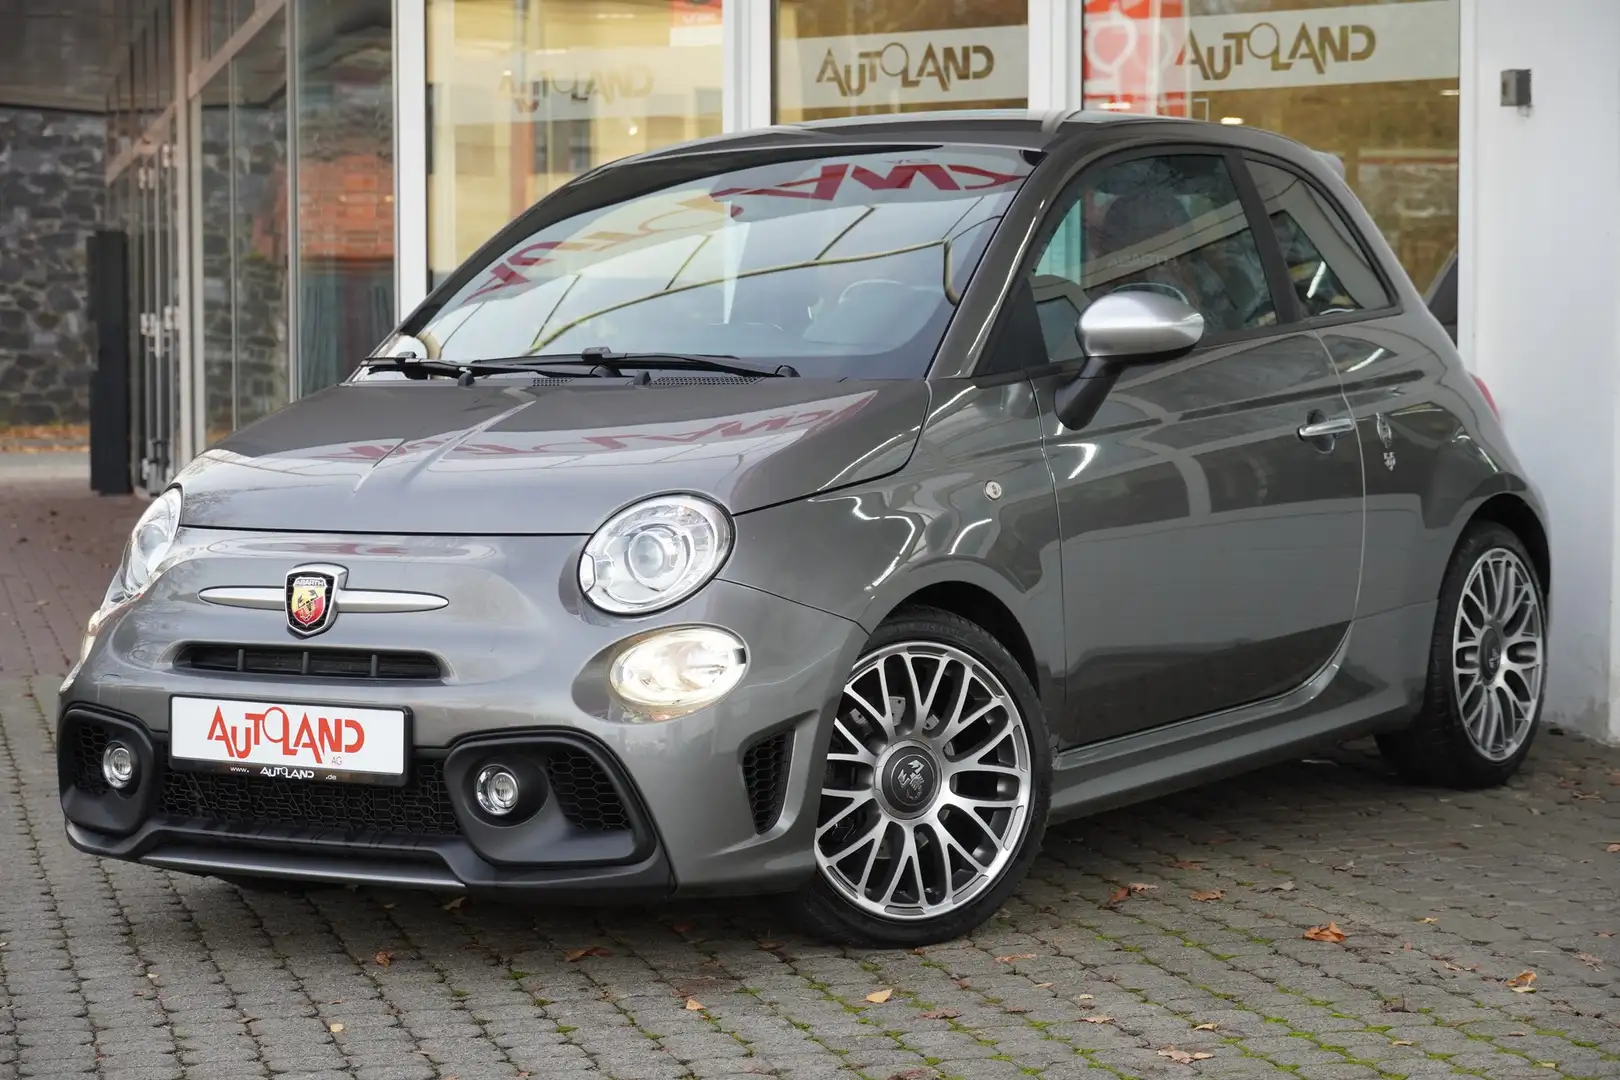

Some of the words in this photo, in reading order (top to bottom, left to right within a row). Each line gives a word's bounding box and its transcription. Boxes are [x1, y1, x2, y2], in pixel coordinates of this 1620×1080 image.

[1175, 21, 1377, 81] AUTOLAND
[815, 42, 995, 97] AUTOLAND
[295, 579, 325, 587] ABARTH
[207, 705, 365, 764] AUTOLAND
[260, 766, 315, 780] AUTOLAND
[331, 755, 343, 766] AG
